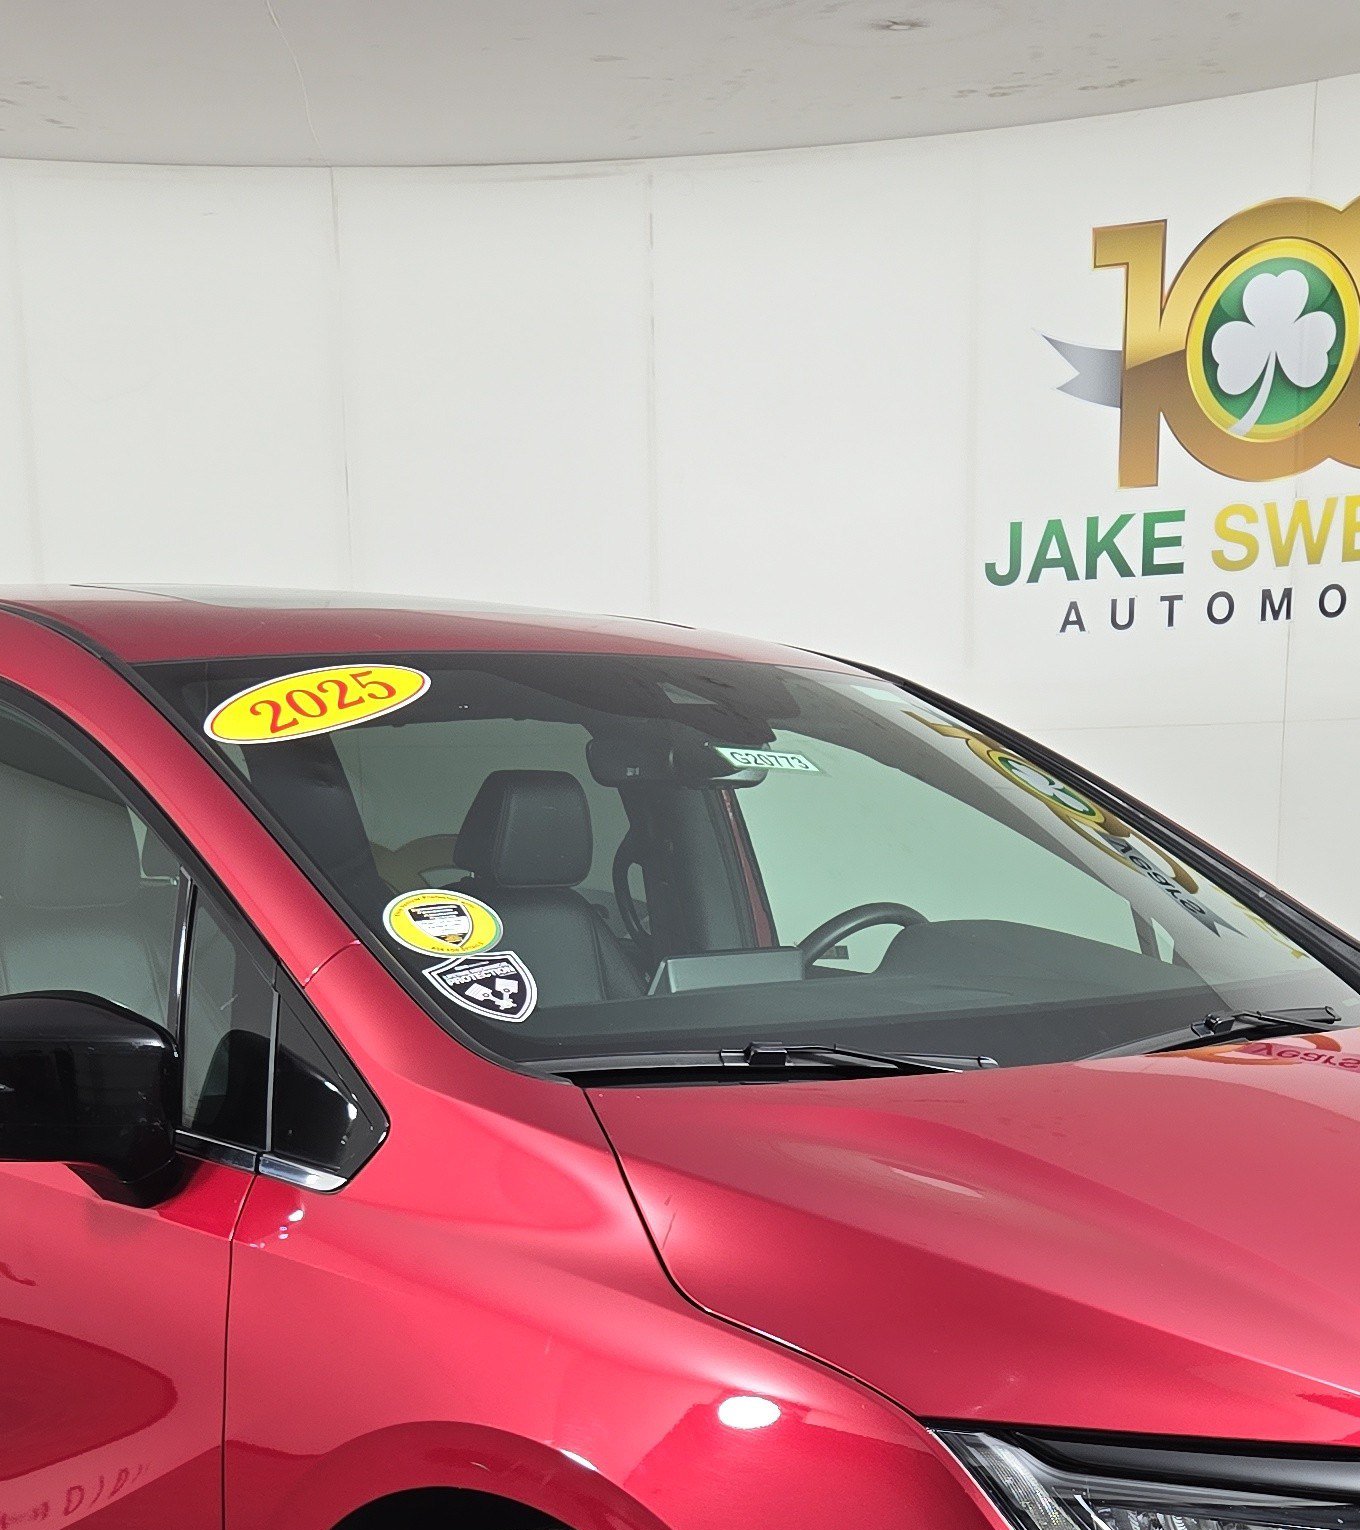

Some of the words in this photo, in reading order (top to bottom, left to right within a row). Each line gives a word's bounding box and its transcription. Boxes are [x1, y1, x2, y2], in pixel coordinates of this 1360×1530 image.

[985, 508, 1186, 587] JAKE
[249, 670, 397, 734] 2025
[730, 752, 809, 769] G20773
